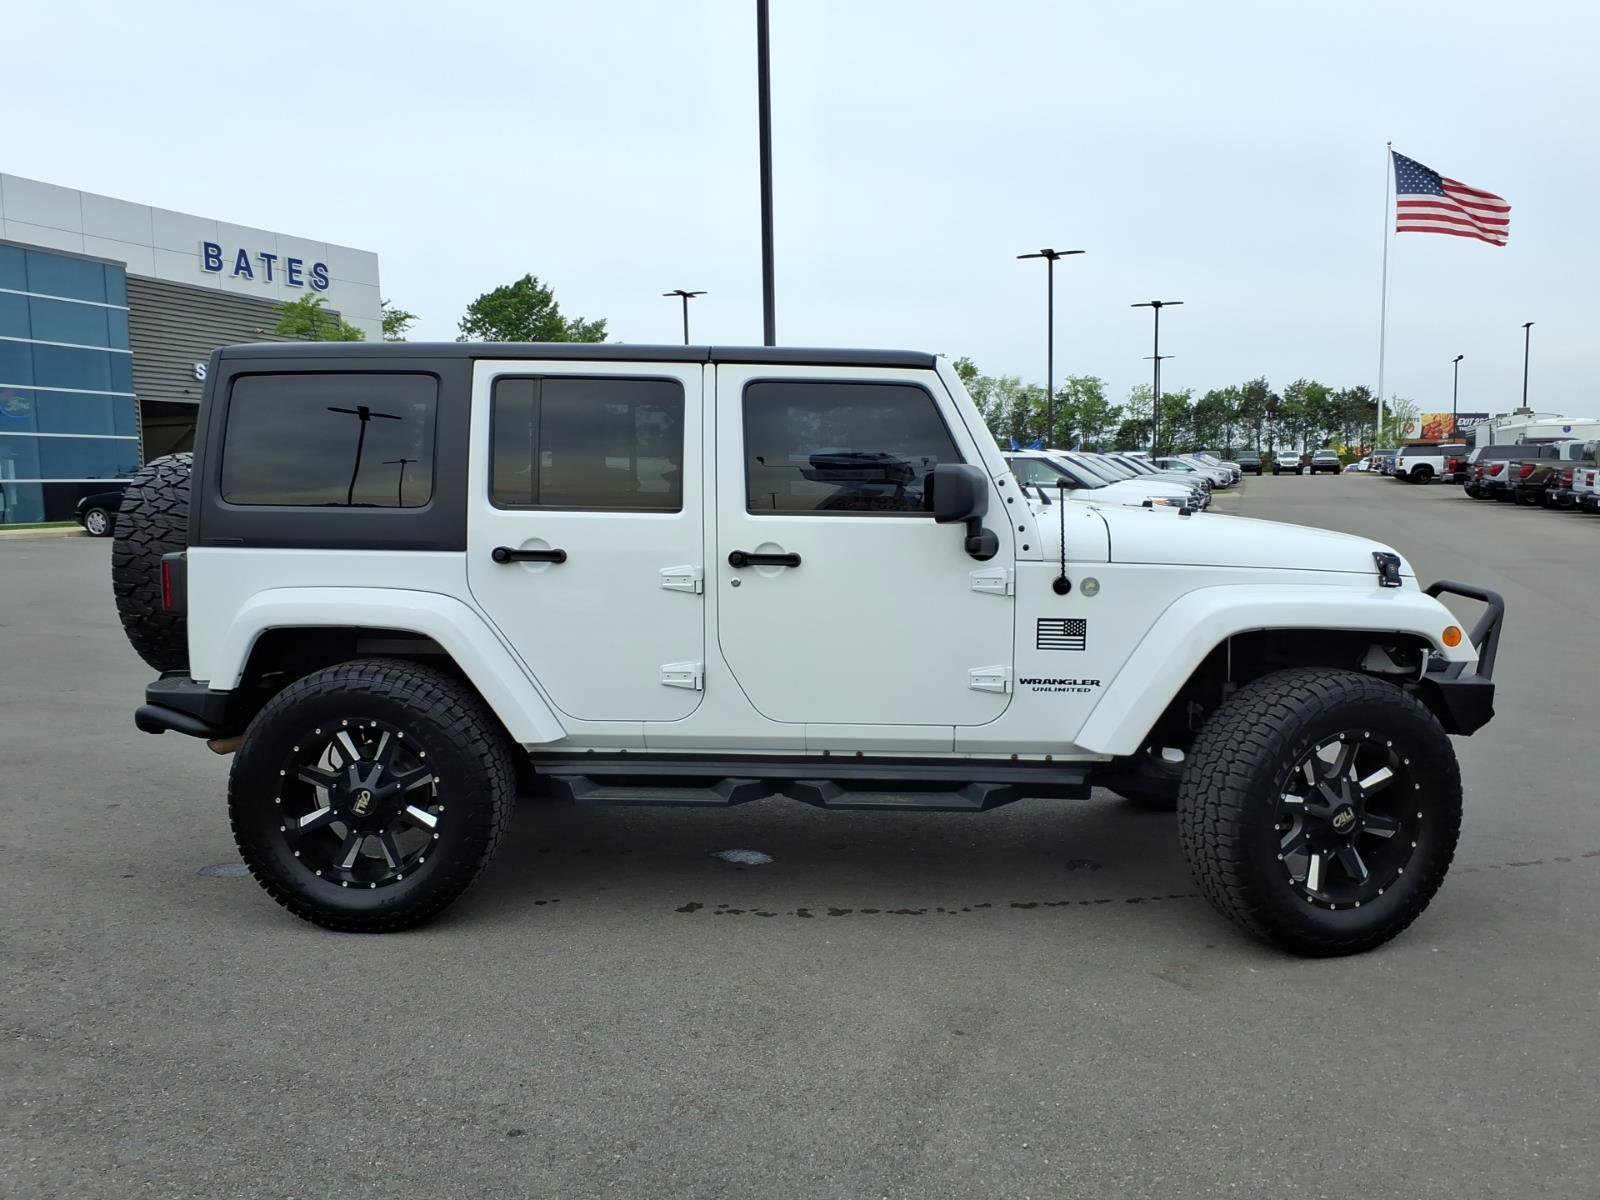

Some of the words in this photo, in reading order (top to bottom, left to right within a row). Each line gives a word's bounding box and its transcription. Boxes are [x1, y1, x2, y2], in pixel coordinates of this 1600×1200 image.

[202, 241, 330, 291] BATES
[1457, 418, 1475, 426] EXIT
[1019, 678, 1101, 687] WRANGLER
